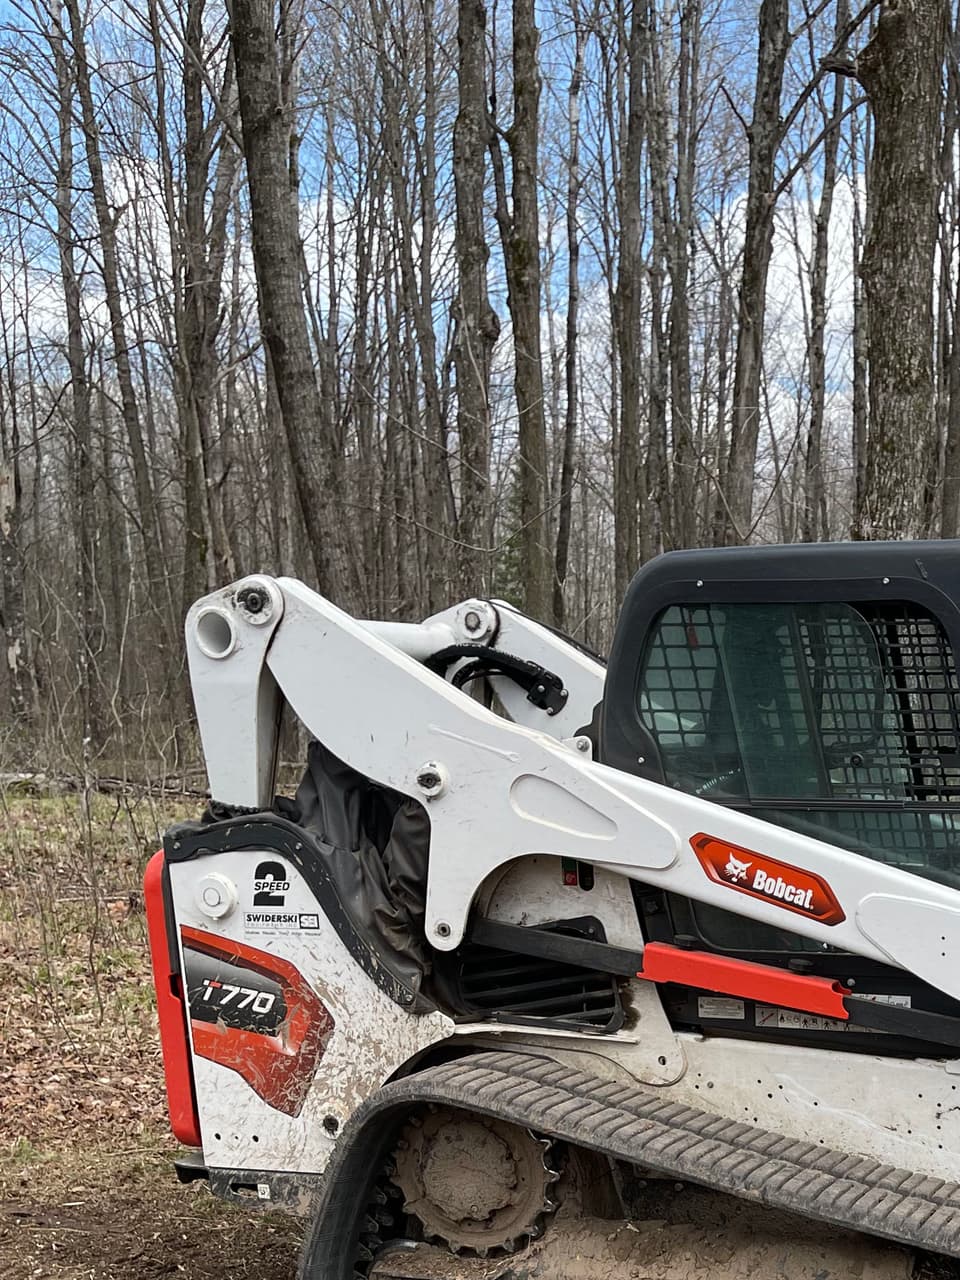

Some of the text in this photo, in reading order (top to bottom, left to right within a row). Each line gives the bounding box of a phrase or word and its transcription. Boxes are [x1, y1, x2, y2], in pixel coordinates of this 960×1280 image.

[253, 861, 287, 906] 2
[254, 881, 290, 891] SPEED
[752, 869, 813, 909] Bobcat
[246, 913, 298, 923] SWIDERSKI
[203, 979, 276, 1014] T770
